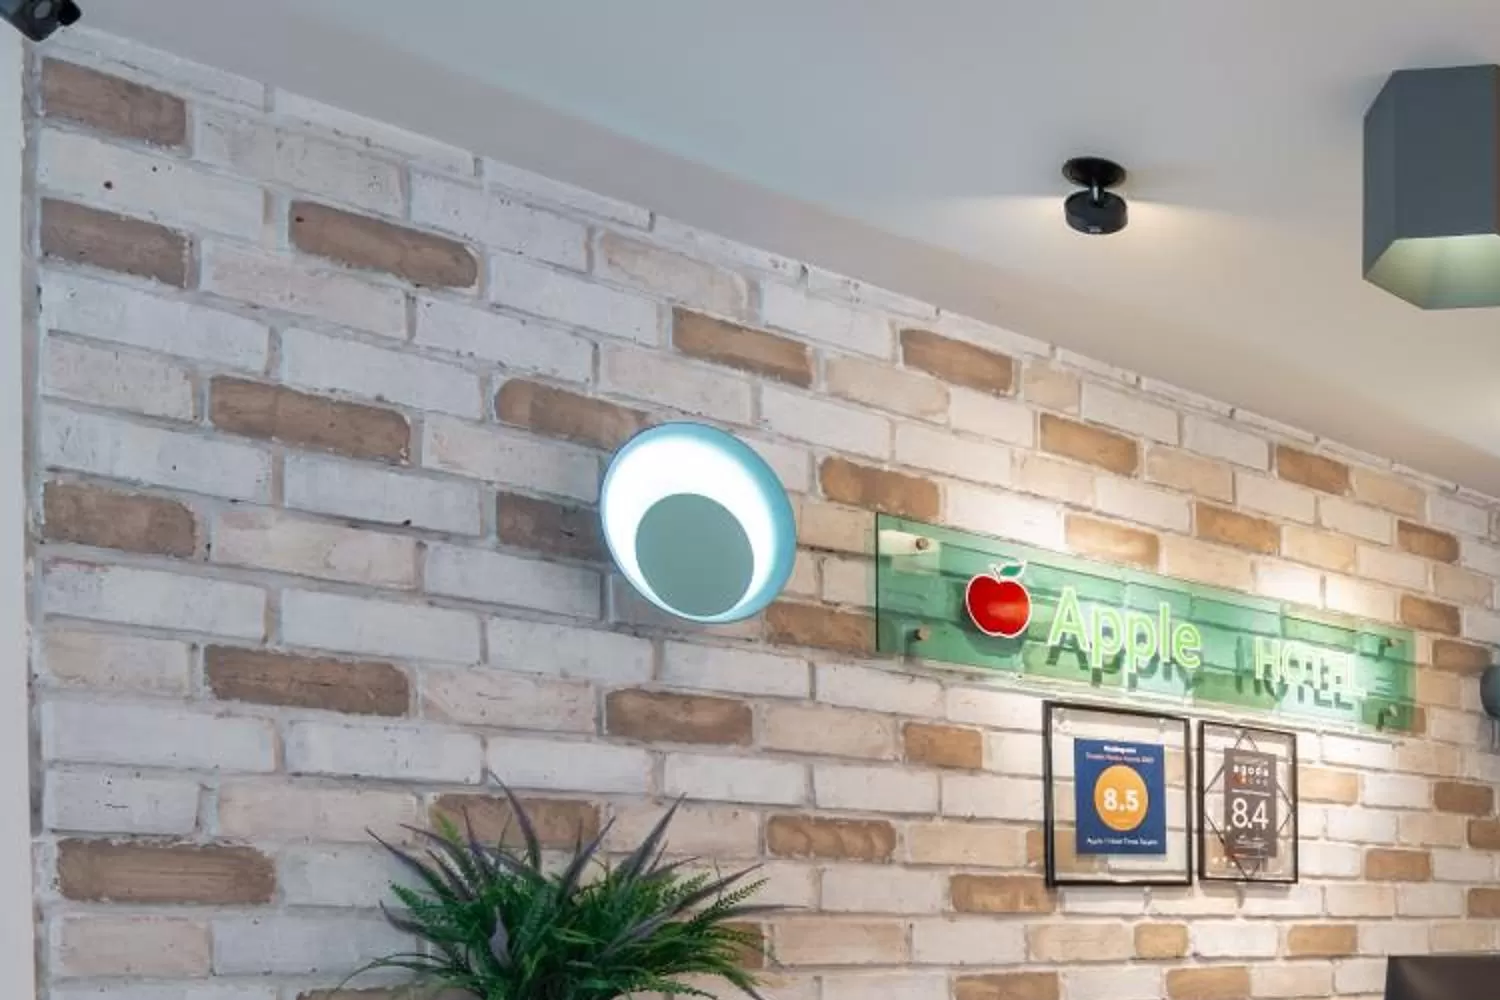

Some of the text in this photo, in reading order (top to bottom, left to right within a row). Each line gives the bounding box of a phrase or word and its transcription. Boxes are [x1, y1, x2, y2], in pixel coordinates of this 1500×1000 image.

[1048, 585, 1202, 675] Apple
[1103, 787, 1139, 812] 8.5
[1232, 797, 1269, 830] 8.4
